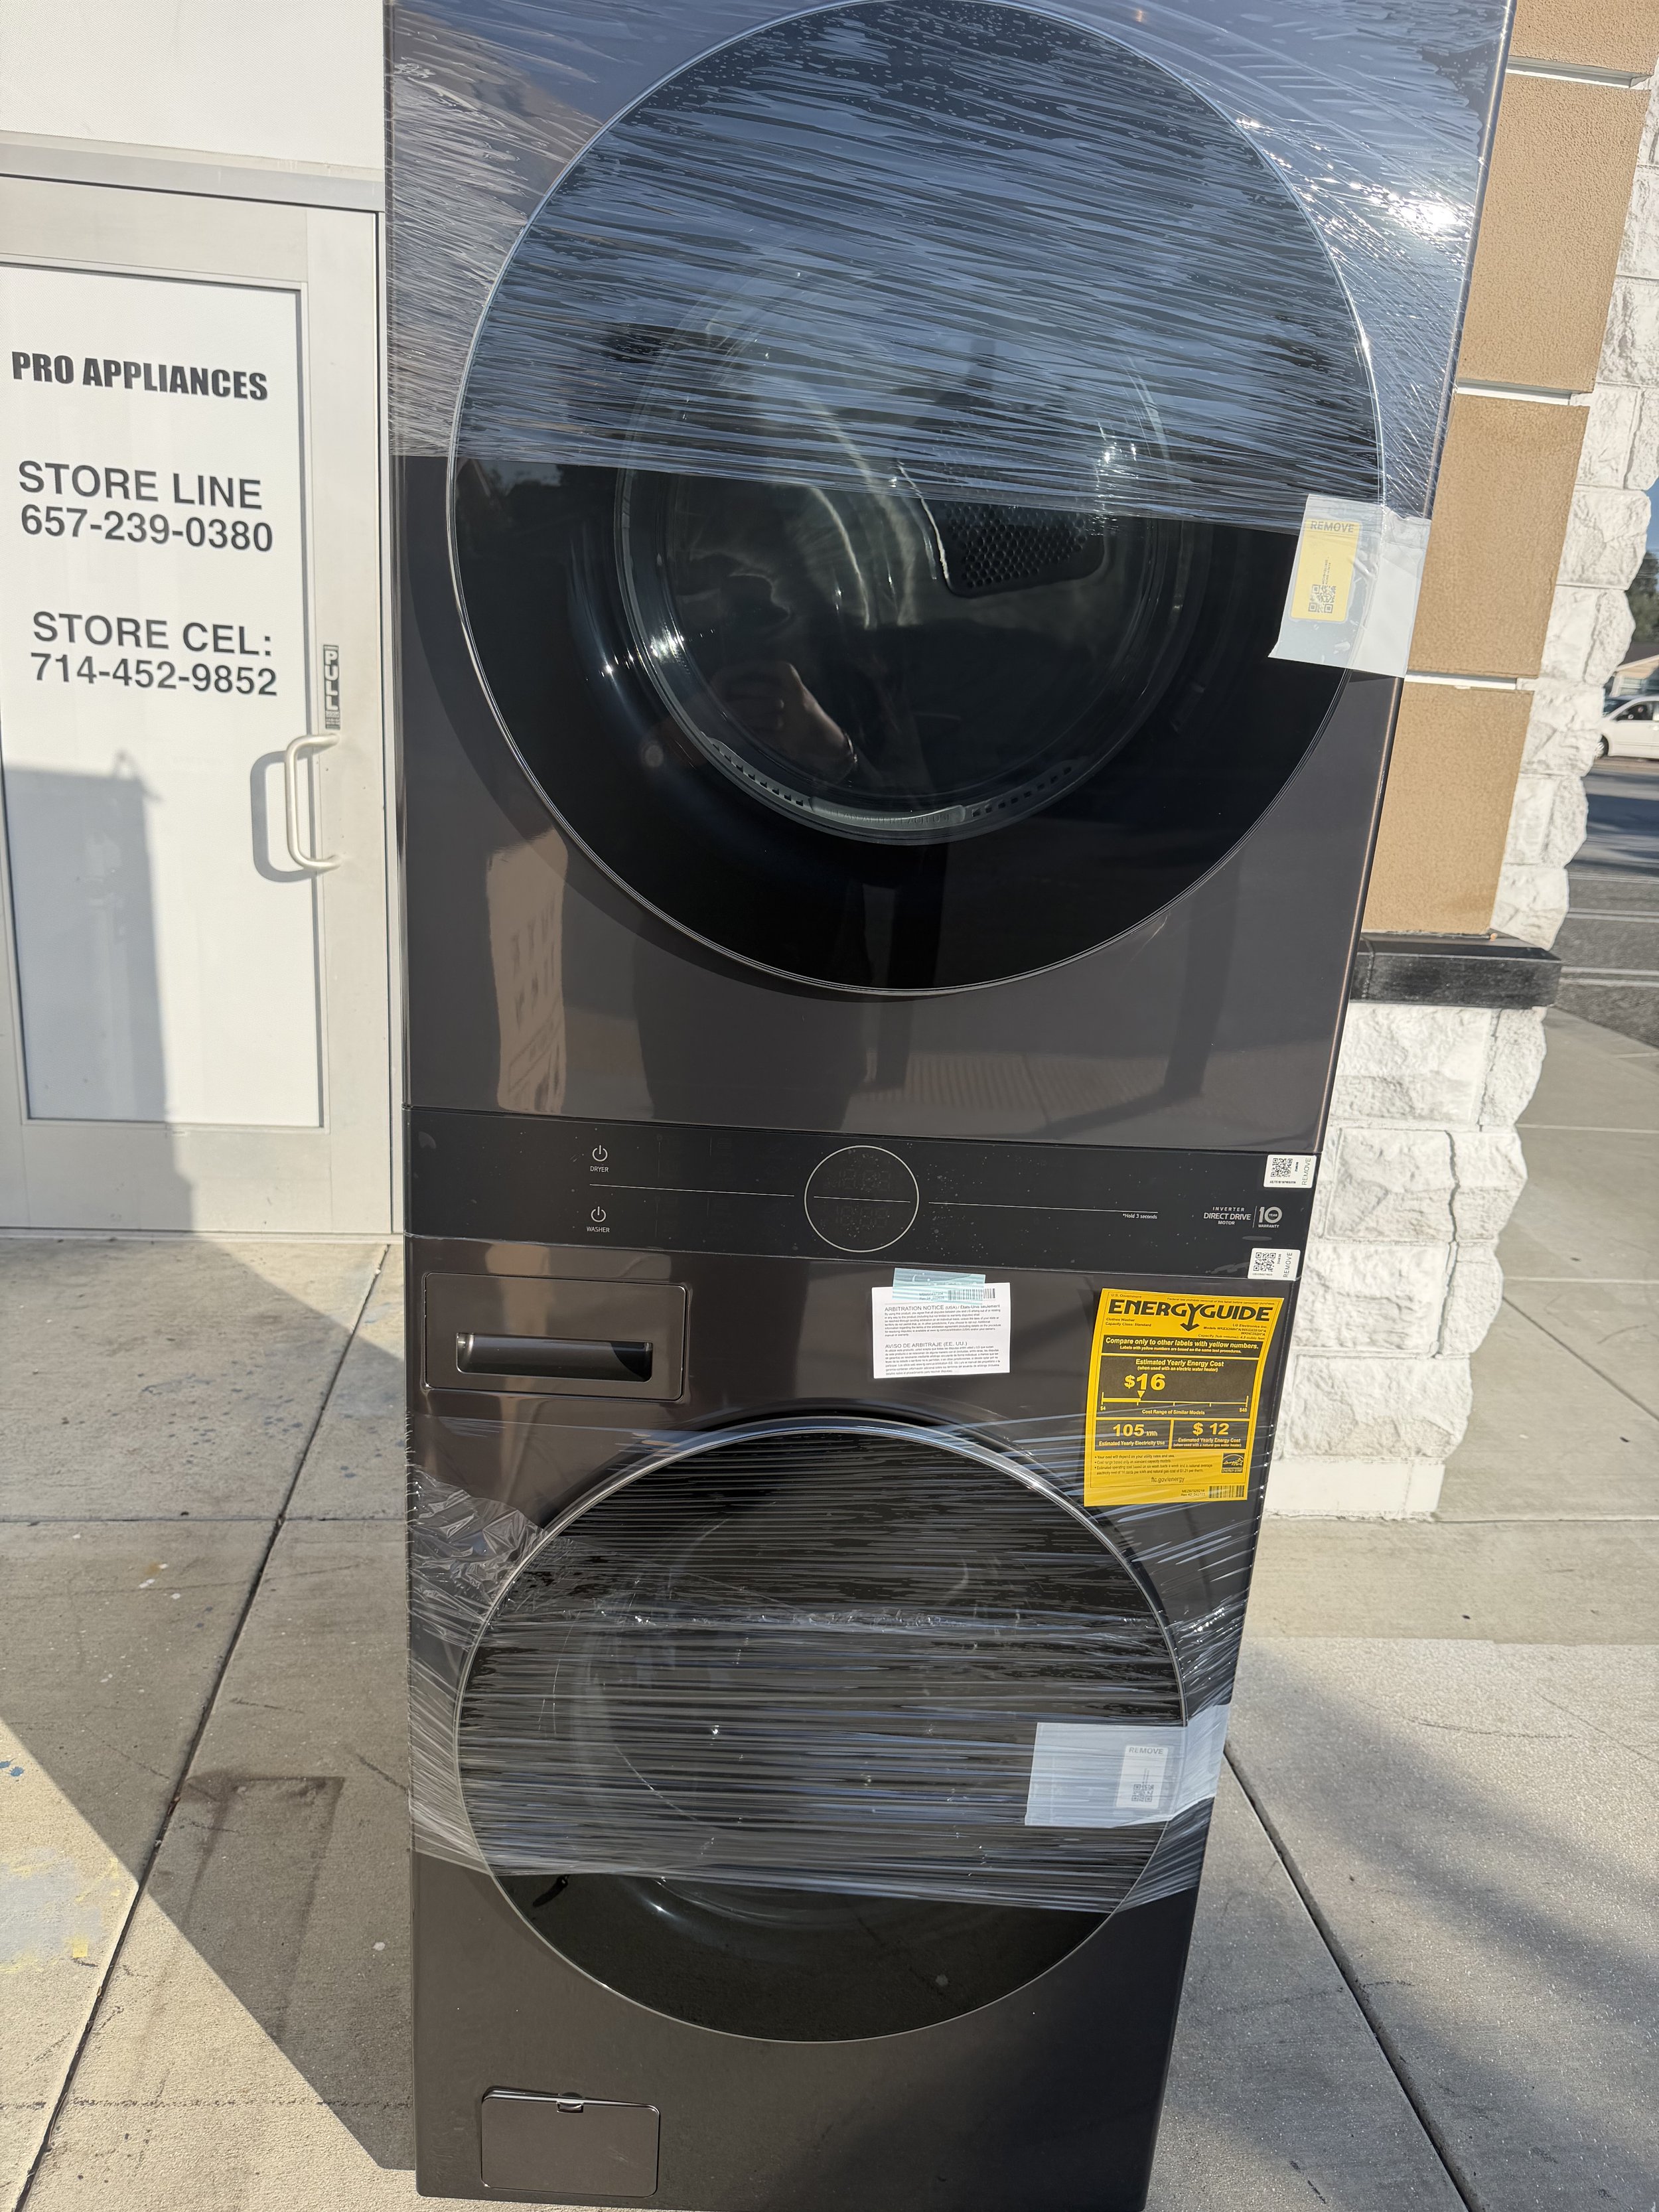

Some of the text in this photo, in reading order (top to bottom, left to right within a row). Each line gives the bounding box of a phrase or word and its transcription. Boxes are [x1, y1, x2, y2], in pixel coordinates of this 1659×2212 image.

[12, 352, 267, 400] PRO APPLIANCES
[19, 461, 262, 509] STORE LINE
[21, 504, 273, 551] 657-239-0380
[1311, 521, 1354, 532] REMOVE
[33, 611, 271, 656] STORE CEL:
[31, 652, 277, 696] 714-452-9852
[325, 650, 339, 711] PULL
[1301, 1158, 1311, 1185] REMOVE
[1258, 1206, 1283, 1224] 10
[1283, 1252, 1293, 1278] REMOVE
[1124, 1373, 1166, 1390] $16
[1113, 1424, 1145, 1437] 105
[1192, 1422, 1229, 1436] $ 12
